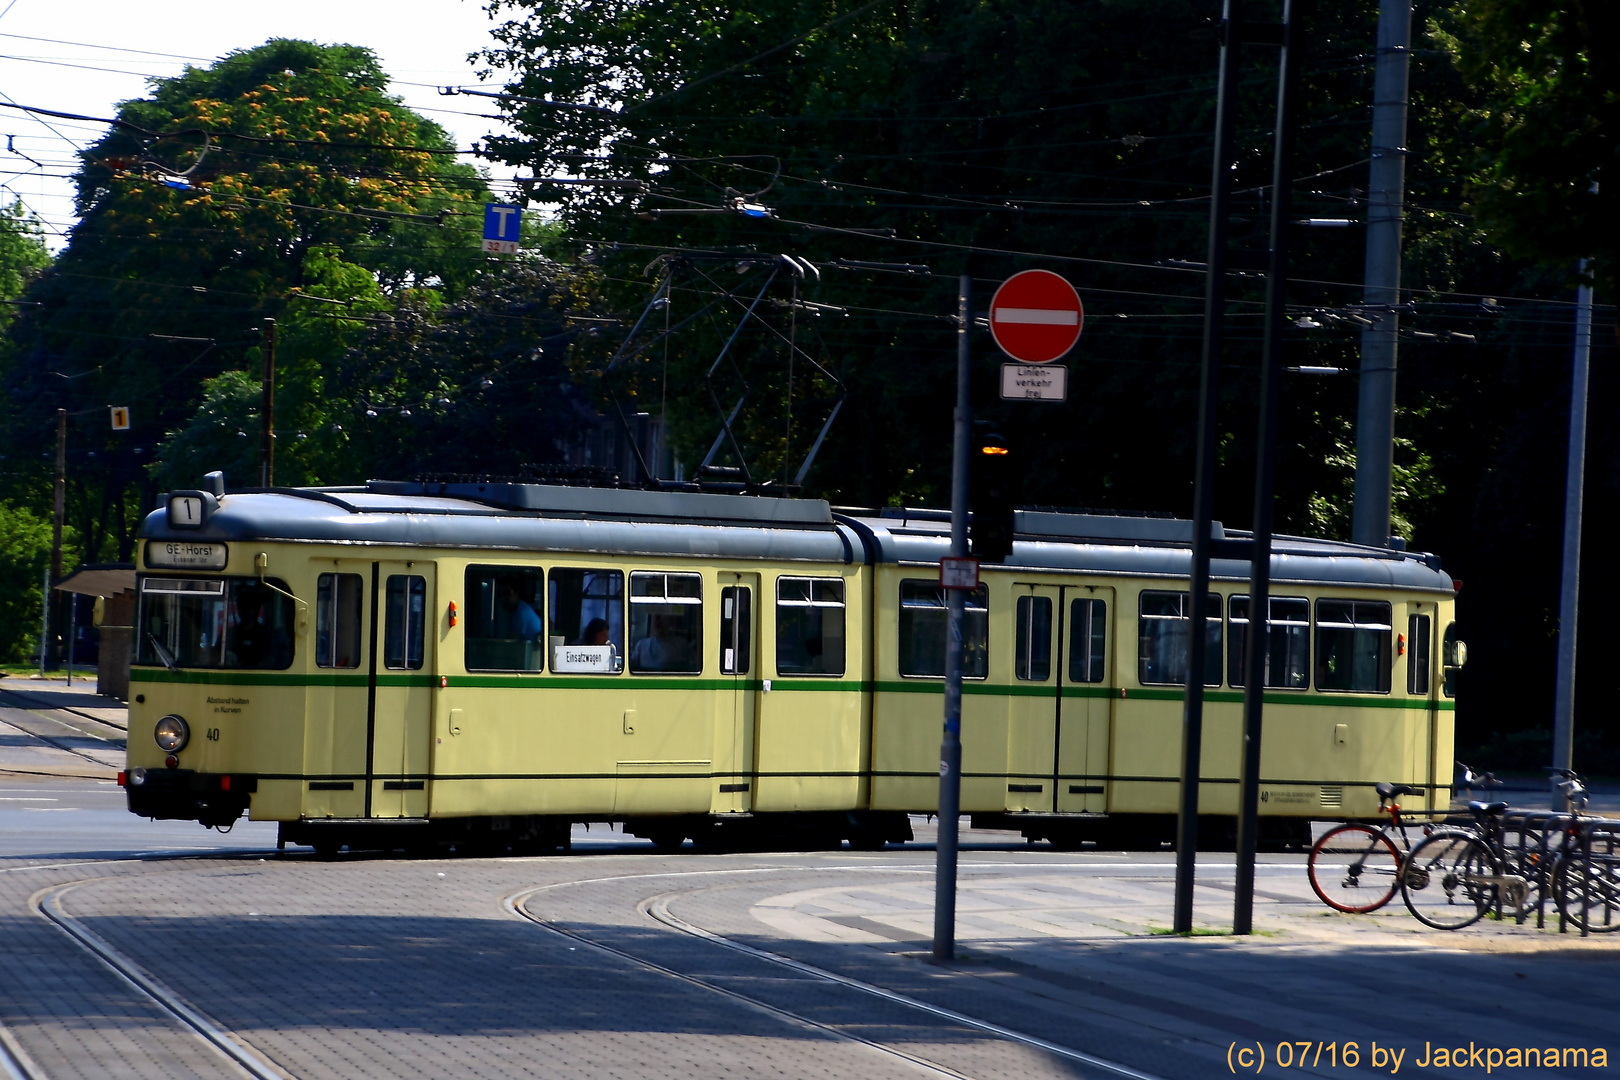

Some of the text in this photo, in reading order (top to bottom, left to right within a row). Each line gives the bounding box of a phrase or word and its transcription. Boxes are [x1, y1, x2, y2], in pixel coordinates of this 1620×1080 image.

[491, 206, 516, 237] T
[1017, 366, 1051, 377] Linien-
[1015, 379, 1052, 387] verkehr
[1025, 389, 1042, 399] frei
[115, 410, 122, 426] 1
[183, 498, 192, 520] 1
[566, 651, 602, 665] Einsatzwagen
[206, 696, 231, 704] Abstand
[206, 727, 220, 741] 40
[1260, 791, 1269, 802] 40
